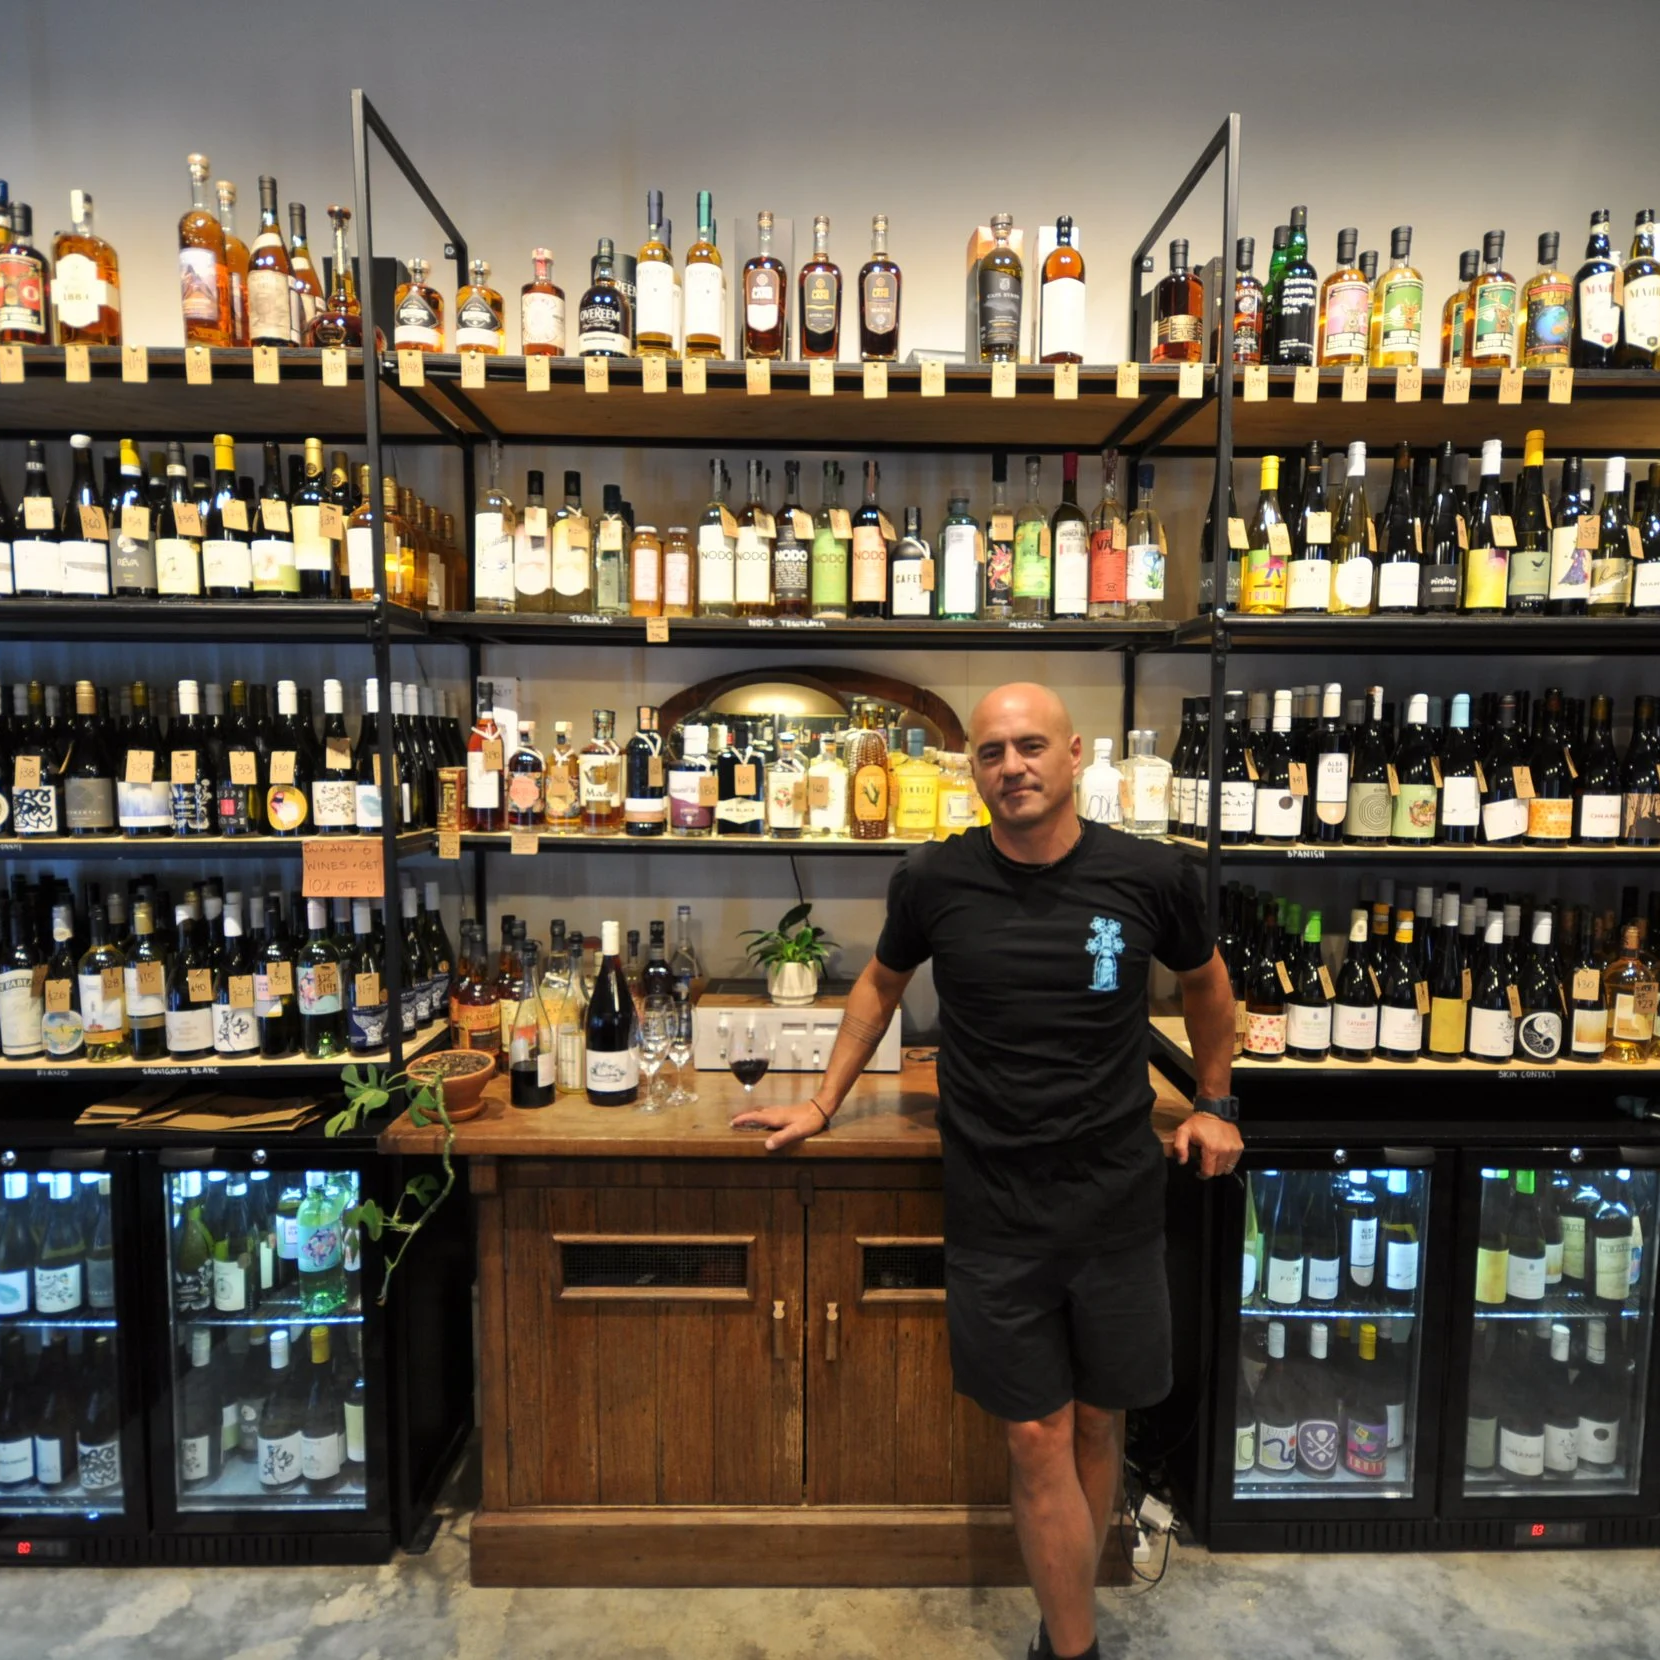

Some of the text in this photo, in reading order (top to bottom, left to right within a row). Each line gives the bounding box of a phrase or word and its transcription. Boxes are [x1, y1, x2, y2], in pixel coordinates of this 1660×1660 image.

[580, 306, 621, 322] OVEREEM
[1399, 379, 1419, 391] $120
[1447, 379, 1469, 392] $130
[701, 551, 732, 561] NODO
[775, 550, 808, 561] NODO
[813, 553, 845, 564] NODO
[854, 550, 885, 561] NODO
[748, 619, 774, 628] NODO
[1008, 621, 1044, 629] MEZCAL
[1287, 850, 1325, 859] SPANISH
[305, 859, 346, 871] WINES
[361, 859, 380, 871] GET
[308, 878, 358, 891] 10% OFF
[1577, 978, 1595, 989] $30
[141, 1066, 220, 1076] SAUVIGNON BLANC
[1498, 1070, 1557, 1079] SKIN CONTACT
